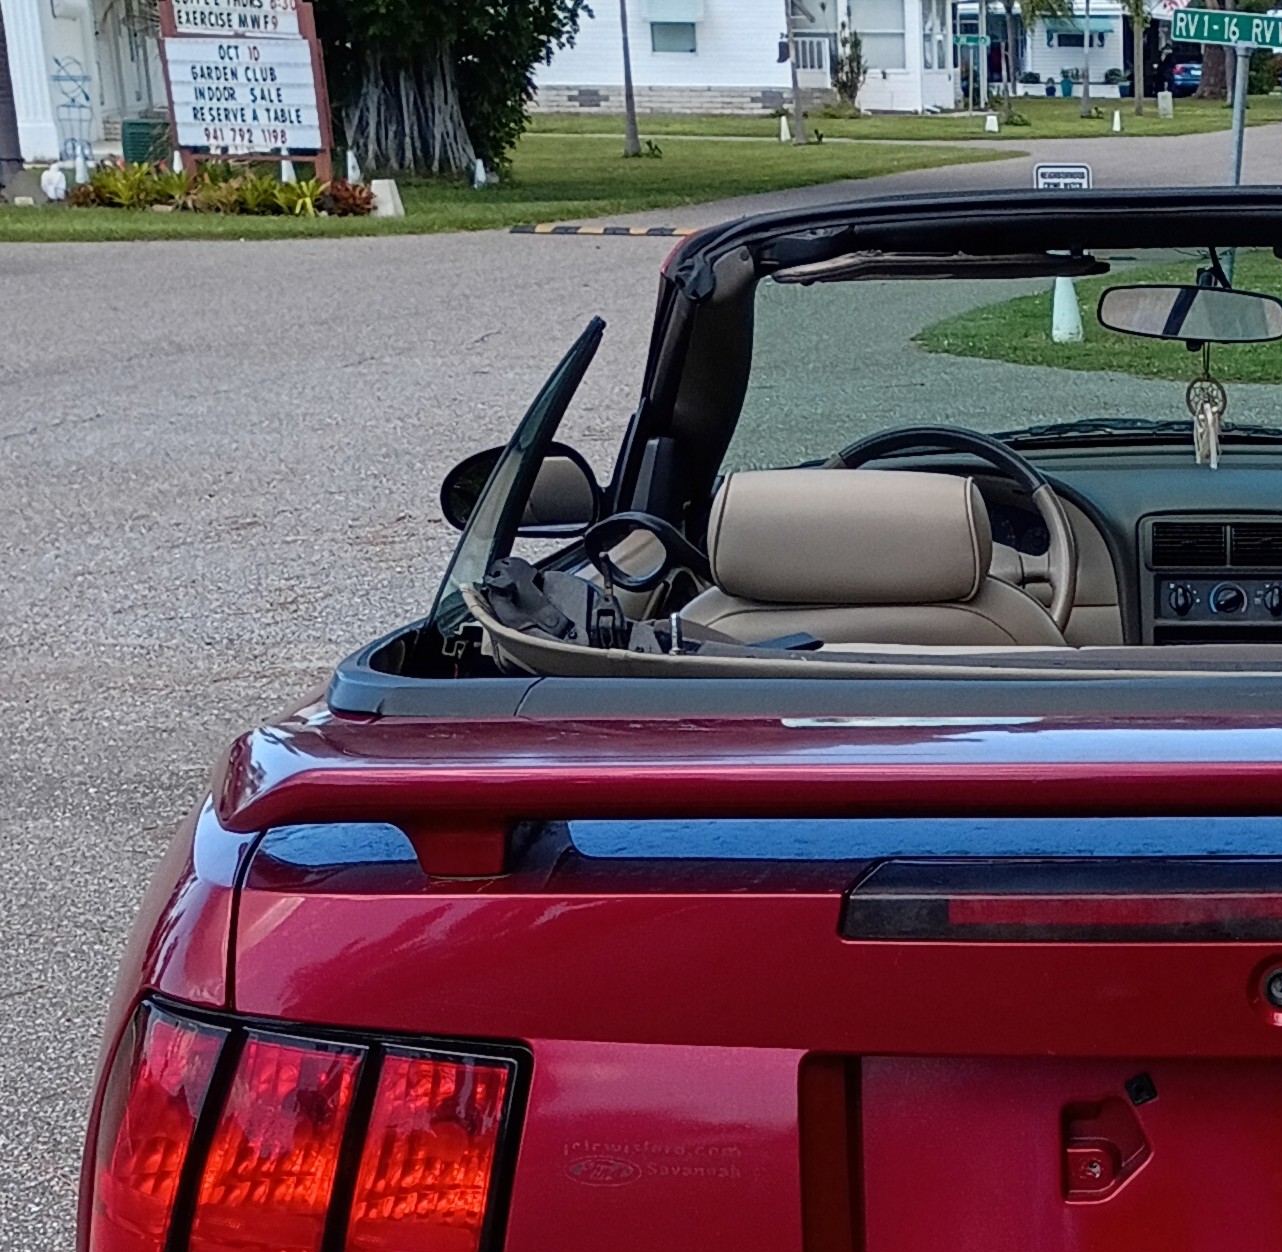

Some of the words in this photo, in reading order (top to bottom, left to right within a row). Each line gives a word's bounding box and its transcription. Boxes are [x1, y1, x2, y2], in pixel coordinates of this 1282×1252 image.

[177, 10, 233, 28] EXERCISE
[1175, 12, 1199, 37] RV
[1252, 19, 1275, 43] RV
[218, 44, 240, 60] OCT
[247, 45, 260, 61] 10
[190, 65, 239, 81] GARDEN
[244, 66, 277, 82] CLUB
[194, 86, 237, 101] INDOOR
[249, 87, 283, 103] SALE
[192, 106, 246, 122] RESERVE
[252, 108, 259, 122] A
[265, 108, 302, 124] TABLE
[204, 127, 224, 142] 941
[230, 127, 253, 143] 792
[262, 128, 287, 144] 1198
